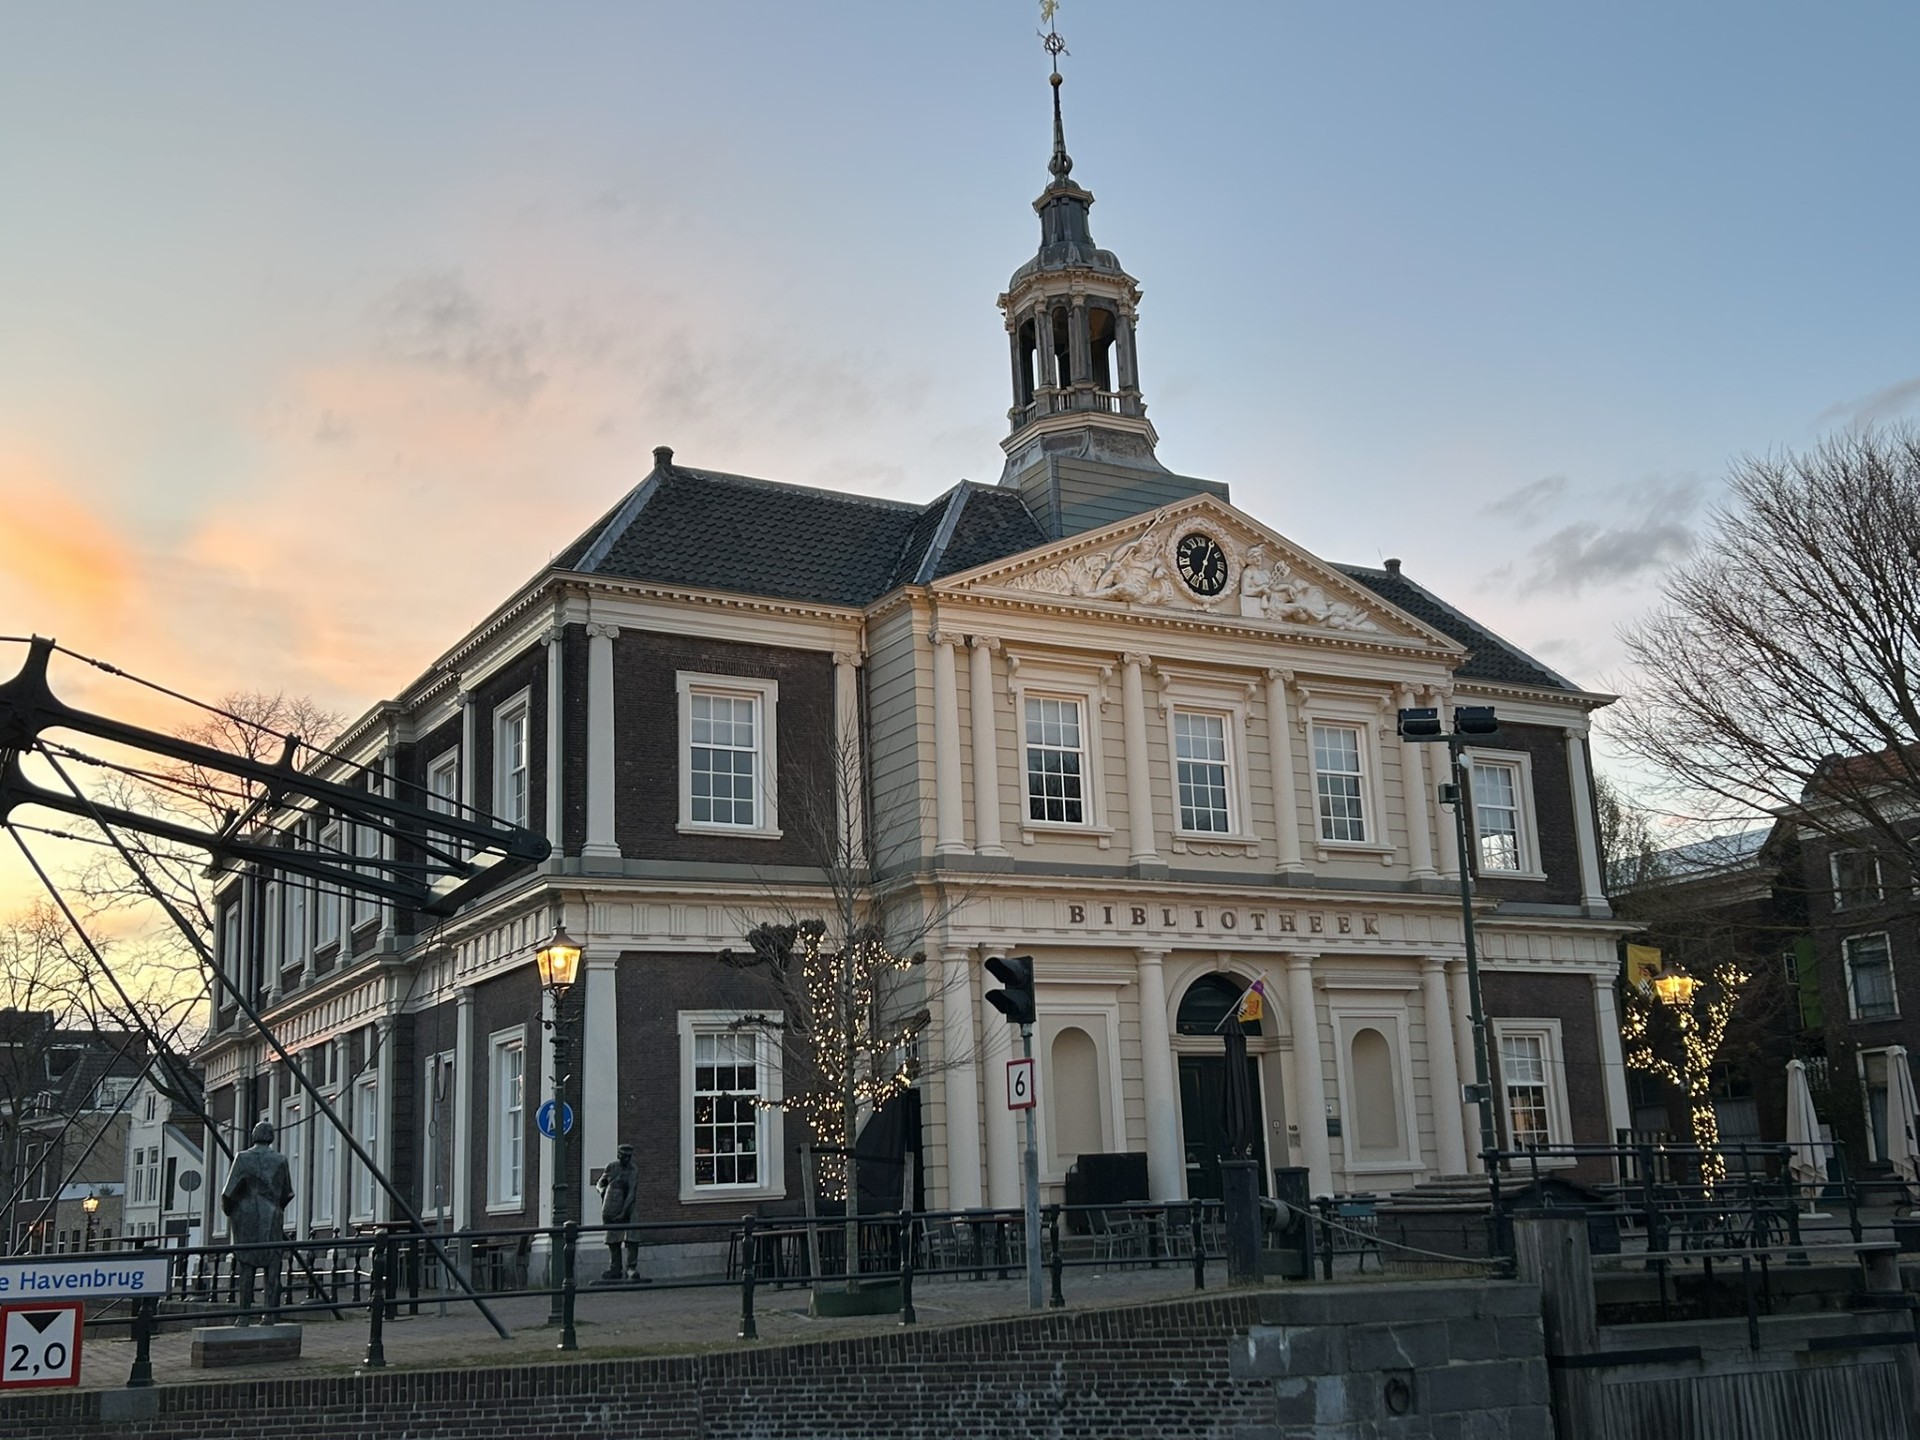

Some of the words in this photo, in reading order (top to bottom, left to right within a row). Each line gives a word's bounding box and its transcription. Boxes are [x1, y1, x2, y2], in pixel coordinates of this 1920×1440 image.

[1069, 905, 1379, 935] BIBLIOTHEEK
[1015, 1070, 1025, 1097] 6
[20, 1269, 145, 1290] Havenbrug
[9, 1342, 67, 1376] 2,0
